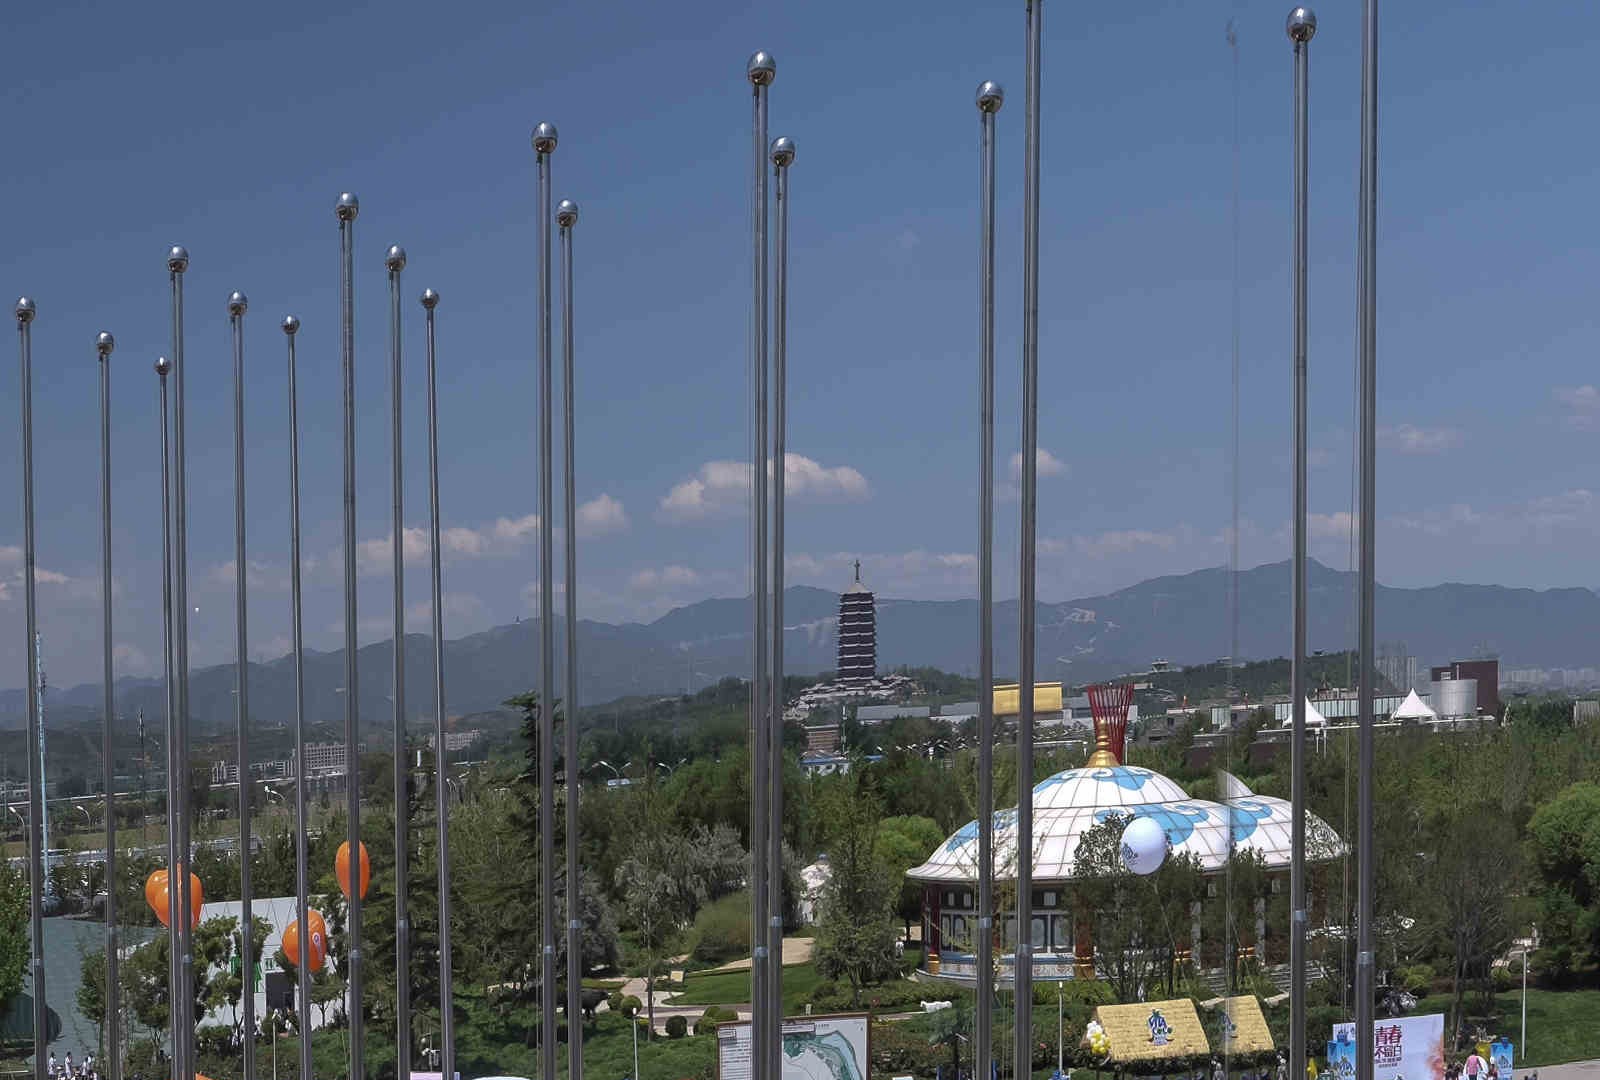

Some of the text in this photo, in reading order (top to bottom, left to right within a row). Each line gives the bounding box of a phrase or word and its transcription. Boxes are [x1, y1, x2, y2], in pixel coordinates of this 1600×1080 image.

[1375, 1025, 1402, 1045] 青春
[1374, 1045, 1402, 1059] 不留白
